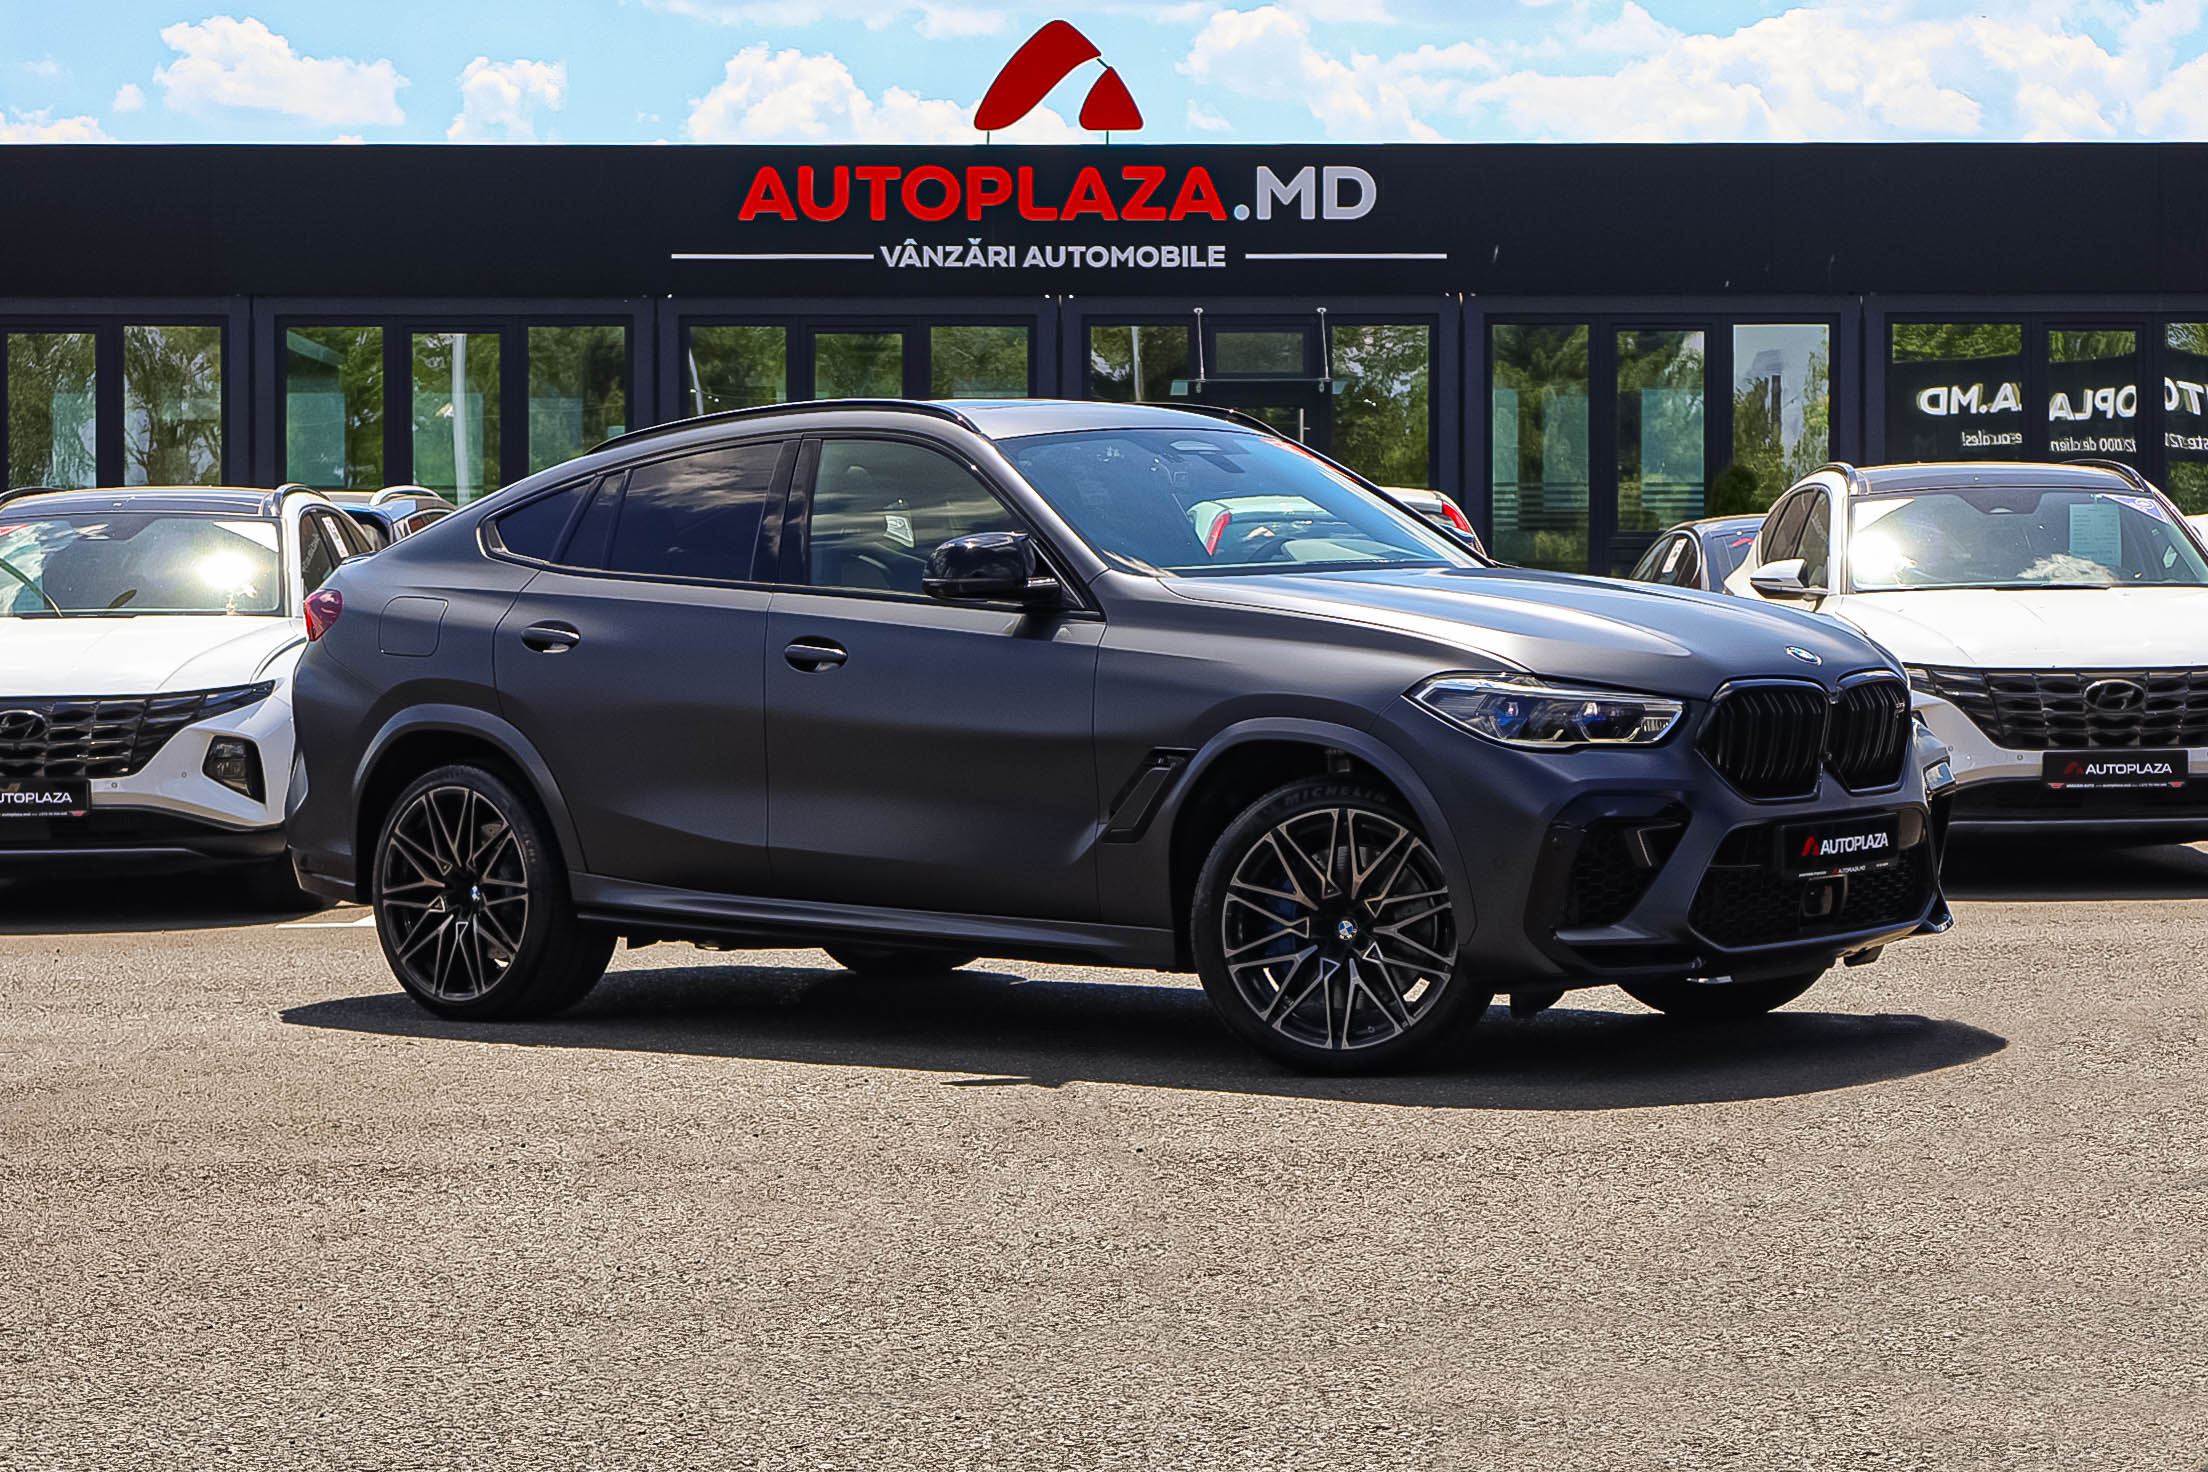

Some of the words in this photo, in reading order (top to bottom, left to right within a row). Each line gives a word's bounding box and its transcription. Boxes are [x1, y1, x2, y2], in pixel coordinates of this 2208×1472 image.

[738, 165, 1377, 221] AUTOPLAZA.MD
[1023, 245, 1226, 268] AUTOMOBILE
[2085, 763, 2173, 775] AUTOPLAZA
[1820, 832, 1889, 856] AUTOPLAZA
